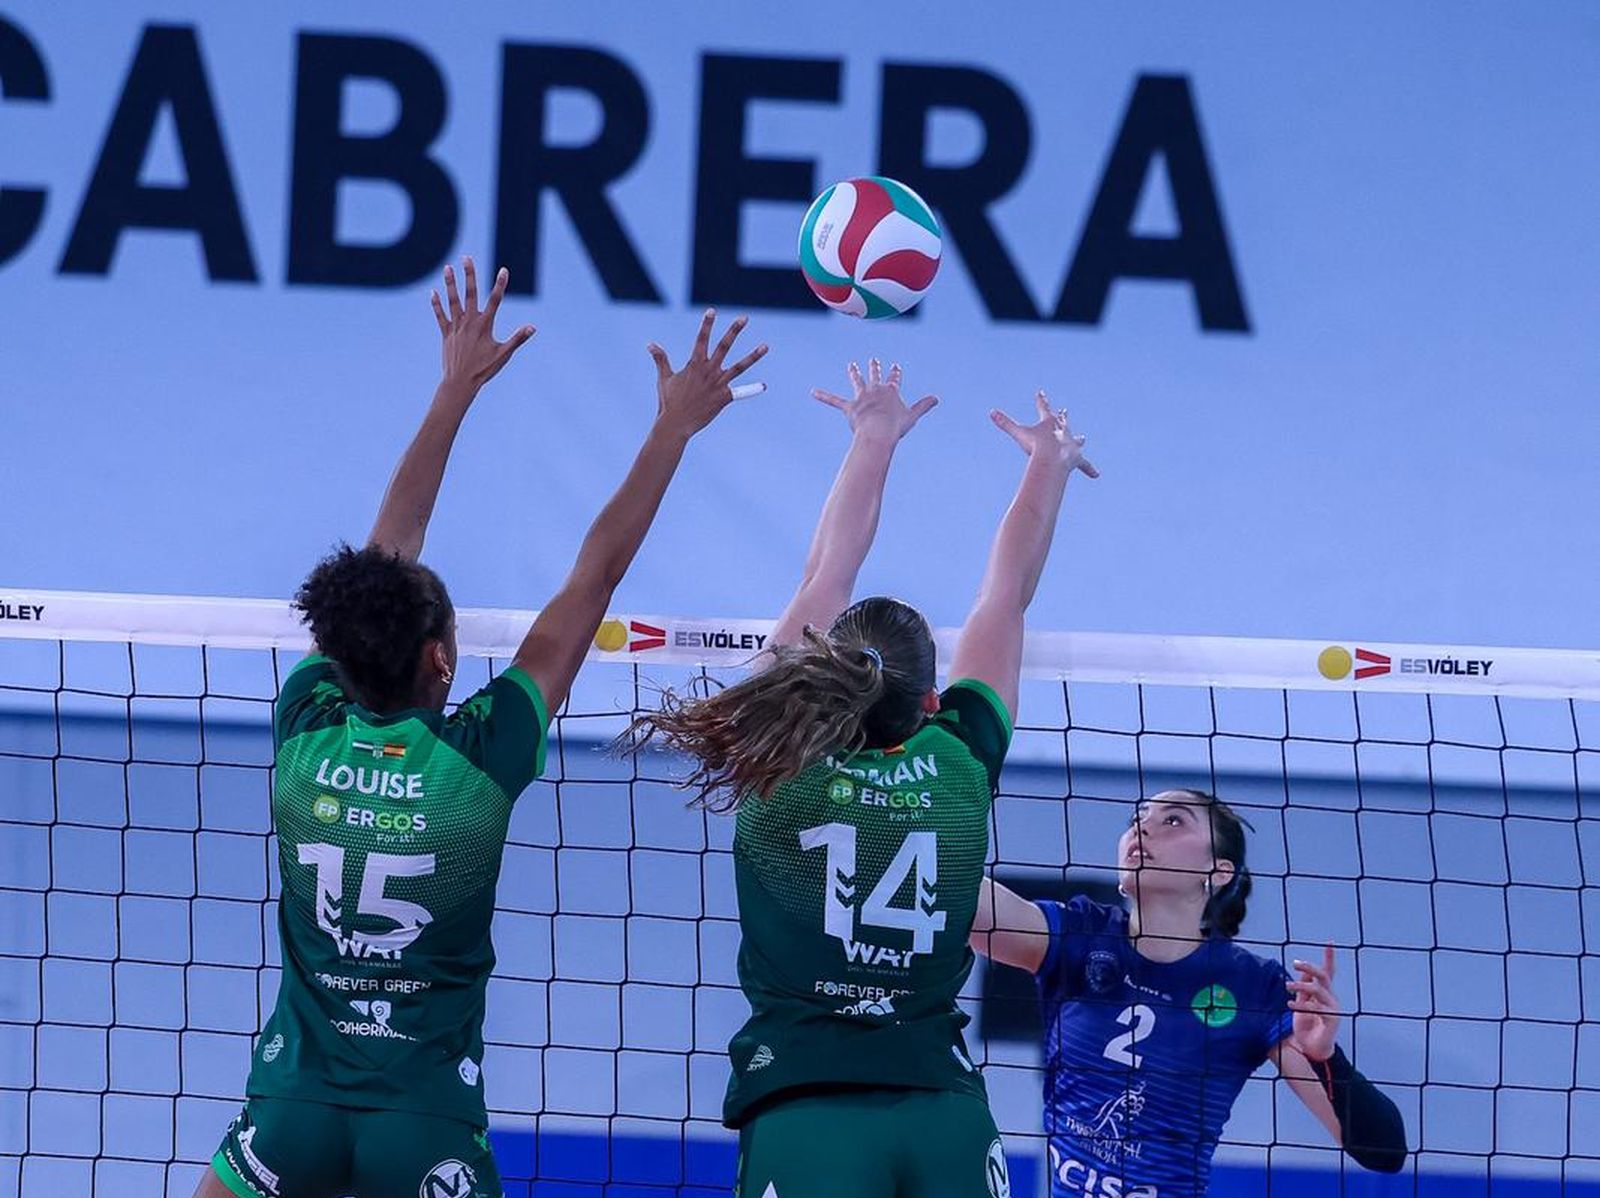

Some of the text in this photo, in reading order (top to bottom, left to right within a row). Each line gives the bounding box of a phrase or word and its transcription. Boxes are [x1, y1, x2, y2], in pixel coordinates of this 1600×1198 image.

[674, 629, 767, 650] ESVÓLEY
[1400, 655, 1494, 676] ESVÓLEY
[315, 758, 425, 799] LOUISE
[860, 787, 932, 808] ERGOS
[346, 806, 427, 832] ERGOS
[297, 842, 436, 951] 15
[799, 822, 947, 954] 14
[815, 980, 885, 1000] FOREVER
[1103, 1003, 1157, 1070] 2
